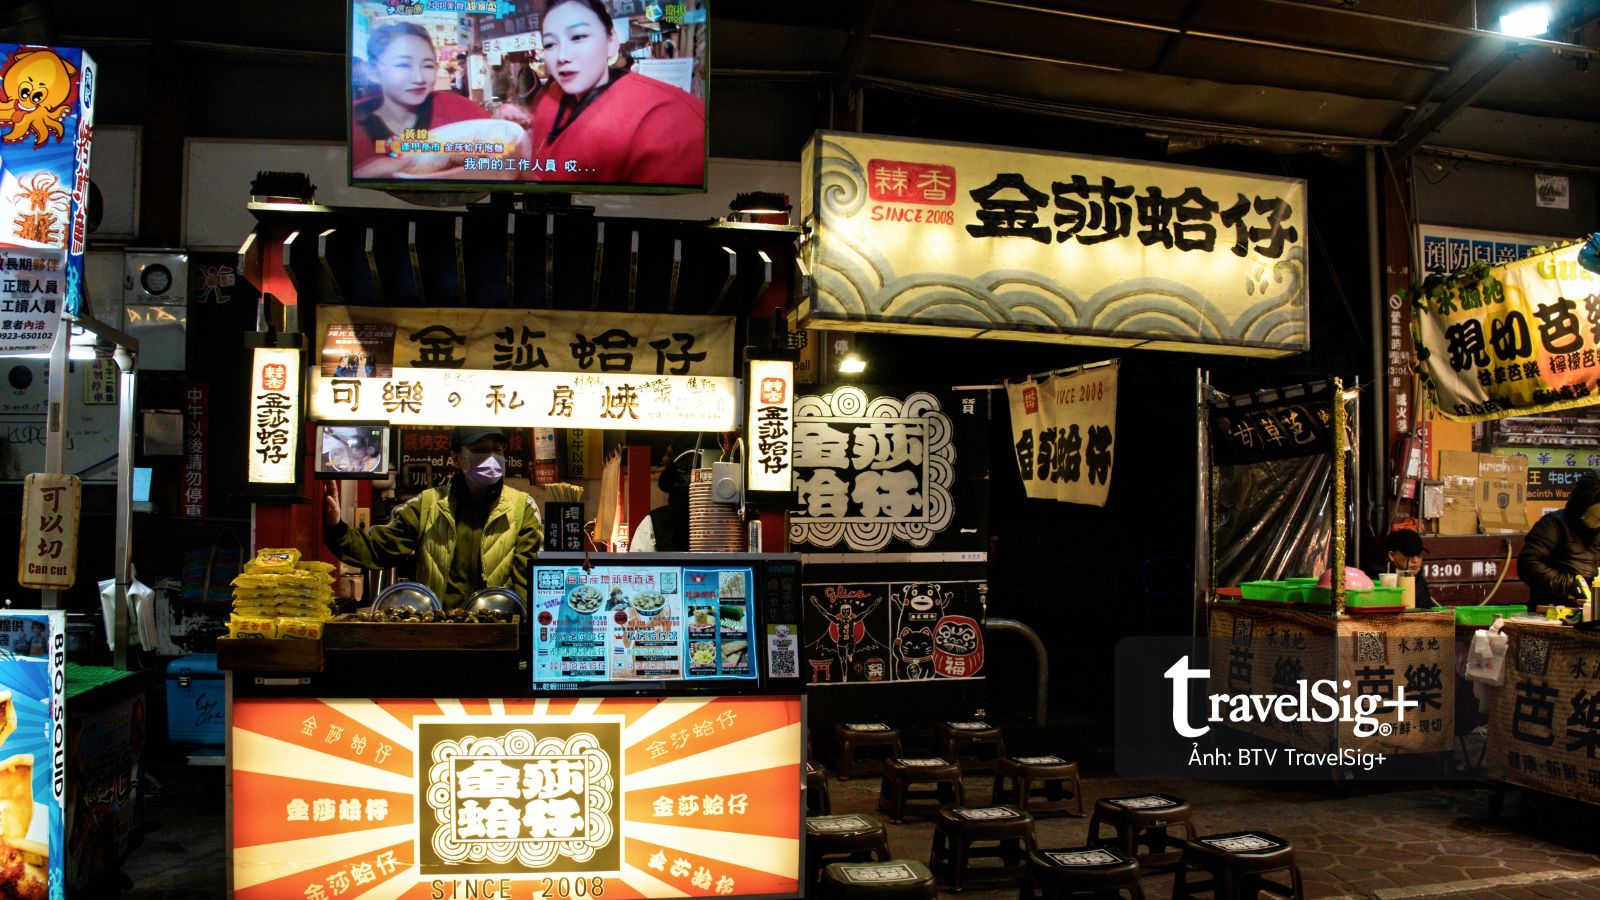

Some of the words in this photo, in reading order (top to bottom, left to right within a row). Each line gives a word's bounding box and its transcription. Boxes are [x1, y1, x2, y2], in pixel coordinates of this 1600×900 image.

[464, 158, 557, 172] 我們的工作人員
[871, 205, 923, 223] SINCE
[925, 209, 954, 226] 2008
[966, 172, 1298, 259] 金莎蛤仔
[3, 279, 58, 294] 正職人員
[1, 300, 56, 313] 工讀人員
[409, 325, 707, 374] 金莎蛤仔
[1478, 361, 1541, 387] 甘草芭樂
[1079, 380, 1103, 403] 2008
[256, 392, 292, 464] 金莎蛤仔
[757, 406, 789, 474] 金莎蛤仔
[185, 387, 204, 517] 中午以後請勿停車
[1529, 470, 1542, 485] 王
[1527, 489, 1553, 498] acinth
[37, 486, 66, 560] 可以切
[28, 563, 48, 576] Can
[50, 564, 67, 576] cut
[566, 574, 656, 585] 每日產地新鮮直送
[1424, 563, 1462, 577] 13:00
[1471, 562, 1497, 576] 開始
[824, 585, 872, 603] Glico
[1398, 637, 1441, 654] 水源地
[944, 656, 966, 675] 福
[300, 715, 392, 764] 金莎蛤仔
[645, 709, 738, 760] 金莎蛤仔
[457, 759, 585, 799] 金莎
[286, 798, 390, 823] 金莎蛤仔
[652, 794, 749, 817] 金莎蛤仔
[457, 798, 585, 839] 蛤仔
[304, 850, 400, 900] 金莎蛤仔
[647, 848, 735, 897] 金莎蛤仔
[431, 877, 512, 900] SINCE
[541, 876, 605, 898] 2008
